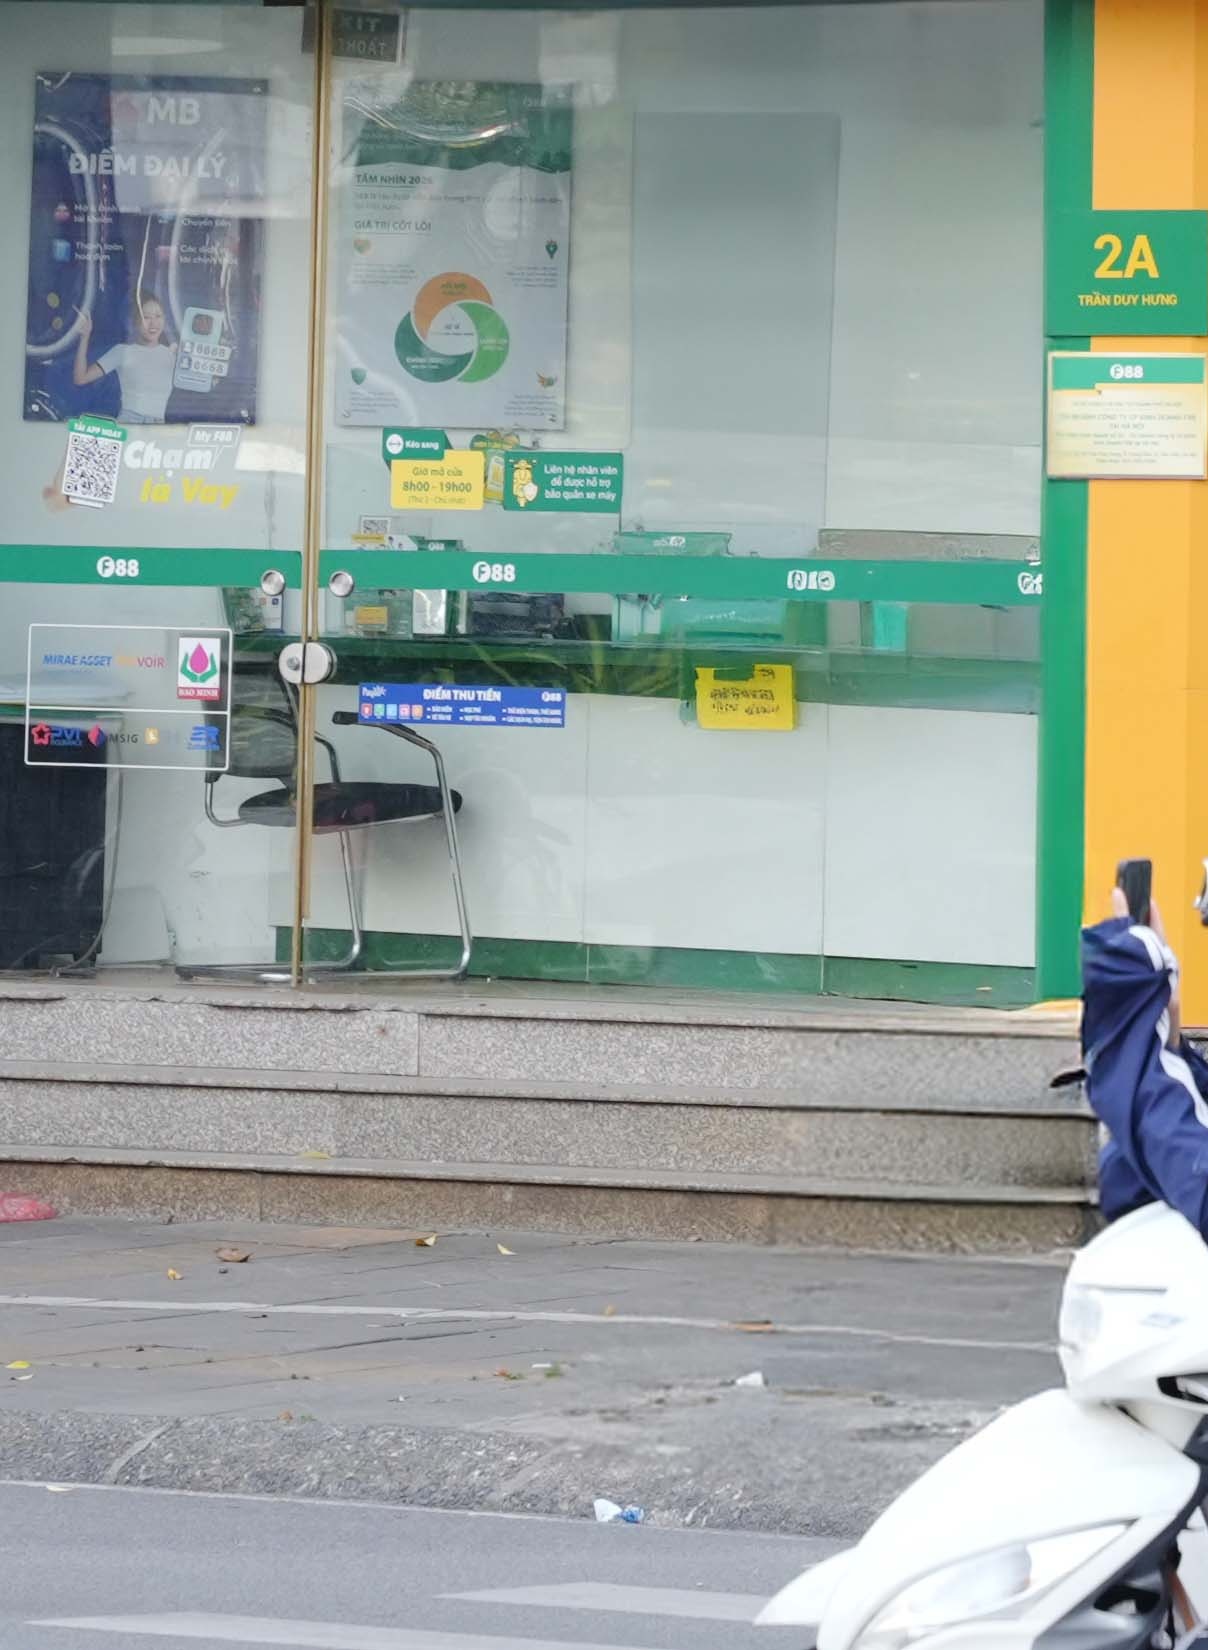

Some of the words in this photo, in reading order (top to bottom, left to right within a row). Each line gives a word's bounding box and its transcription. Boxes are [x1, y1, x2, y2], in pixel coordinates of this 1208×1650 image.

[146, 97, 200, 125] MB
[69, 146, 136, 176] ĐIỂM
[144, 154, 188, 183] ĐẠI
[198, 152, 228, 178] LÝ
[1094, 233, 1160, 279] 2A
[1078, 291, 1111, 306] TRẦN
[1113, 294, 1140, 306] DUY
[1141, 293, 1178, 306] HƯNG
[1110, 363, 1144, 379] F88
[195, 430, 211, 443] My
[212, 430, 233, 442] F88
[124, 440, 213, 478] Chạm
[544, 463, 562, 475] Liên
[140, 474, 172, 502] là
[182, 476, 239, 510] Vay
[402, 481, 431, 493] 8h00
[440, 482, 473, 493] 19h00
[96, 556, 139, 578] F88
[473, 561, 516, 583] F88
[43, 655, 78, 665] MIRAE
[79, 655, 112, 667] ASSET
[196, 689, 219, 699] MINH
[423, 686, 452, 701] ĐIỂM
[453, 690, 475, 701] THU
[476, 688, 502, 702] TIỀN
[107, 733, 139, 744] MSIG
